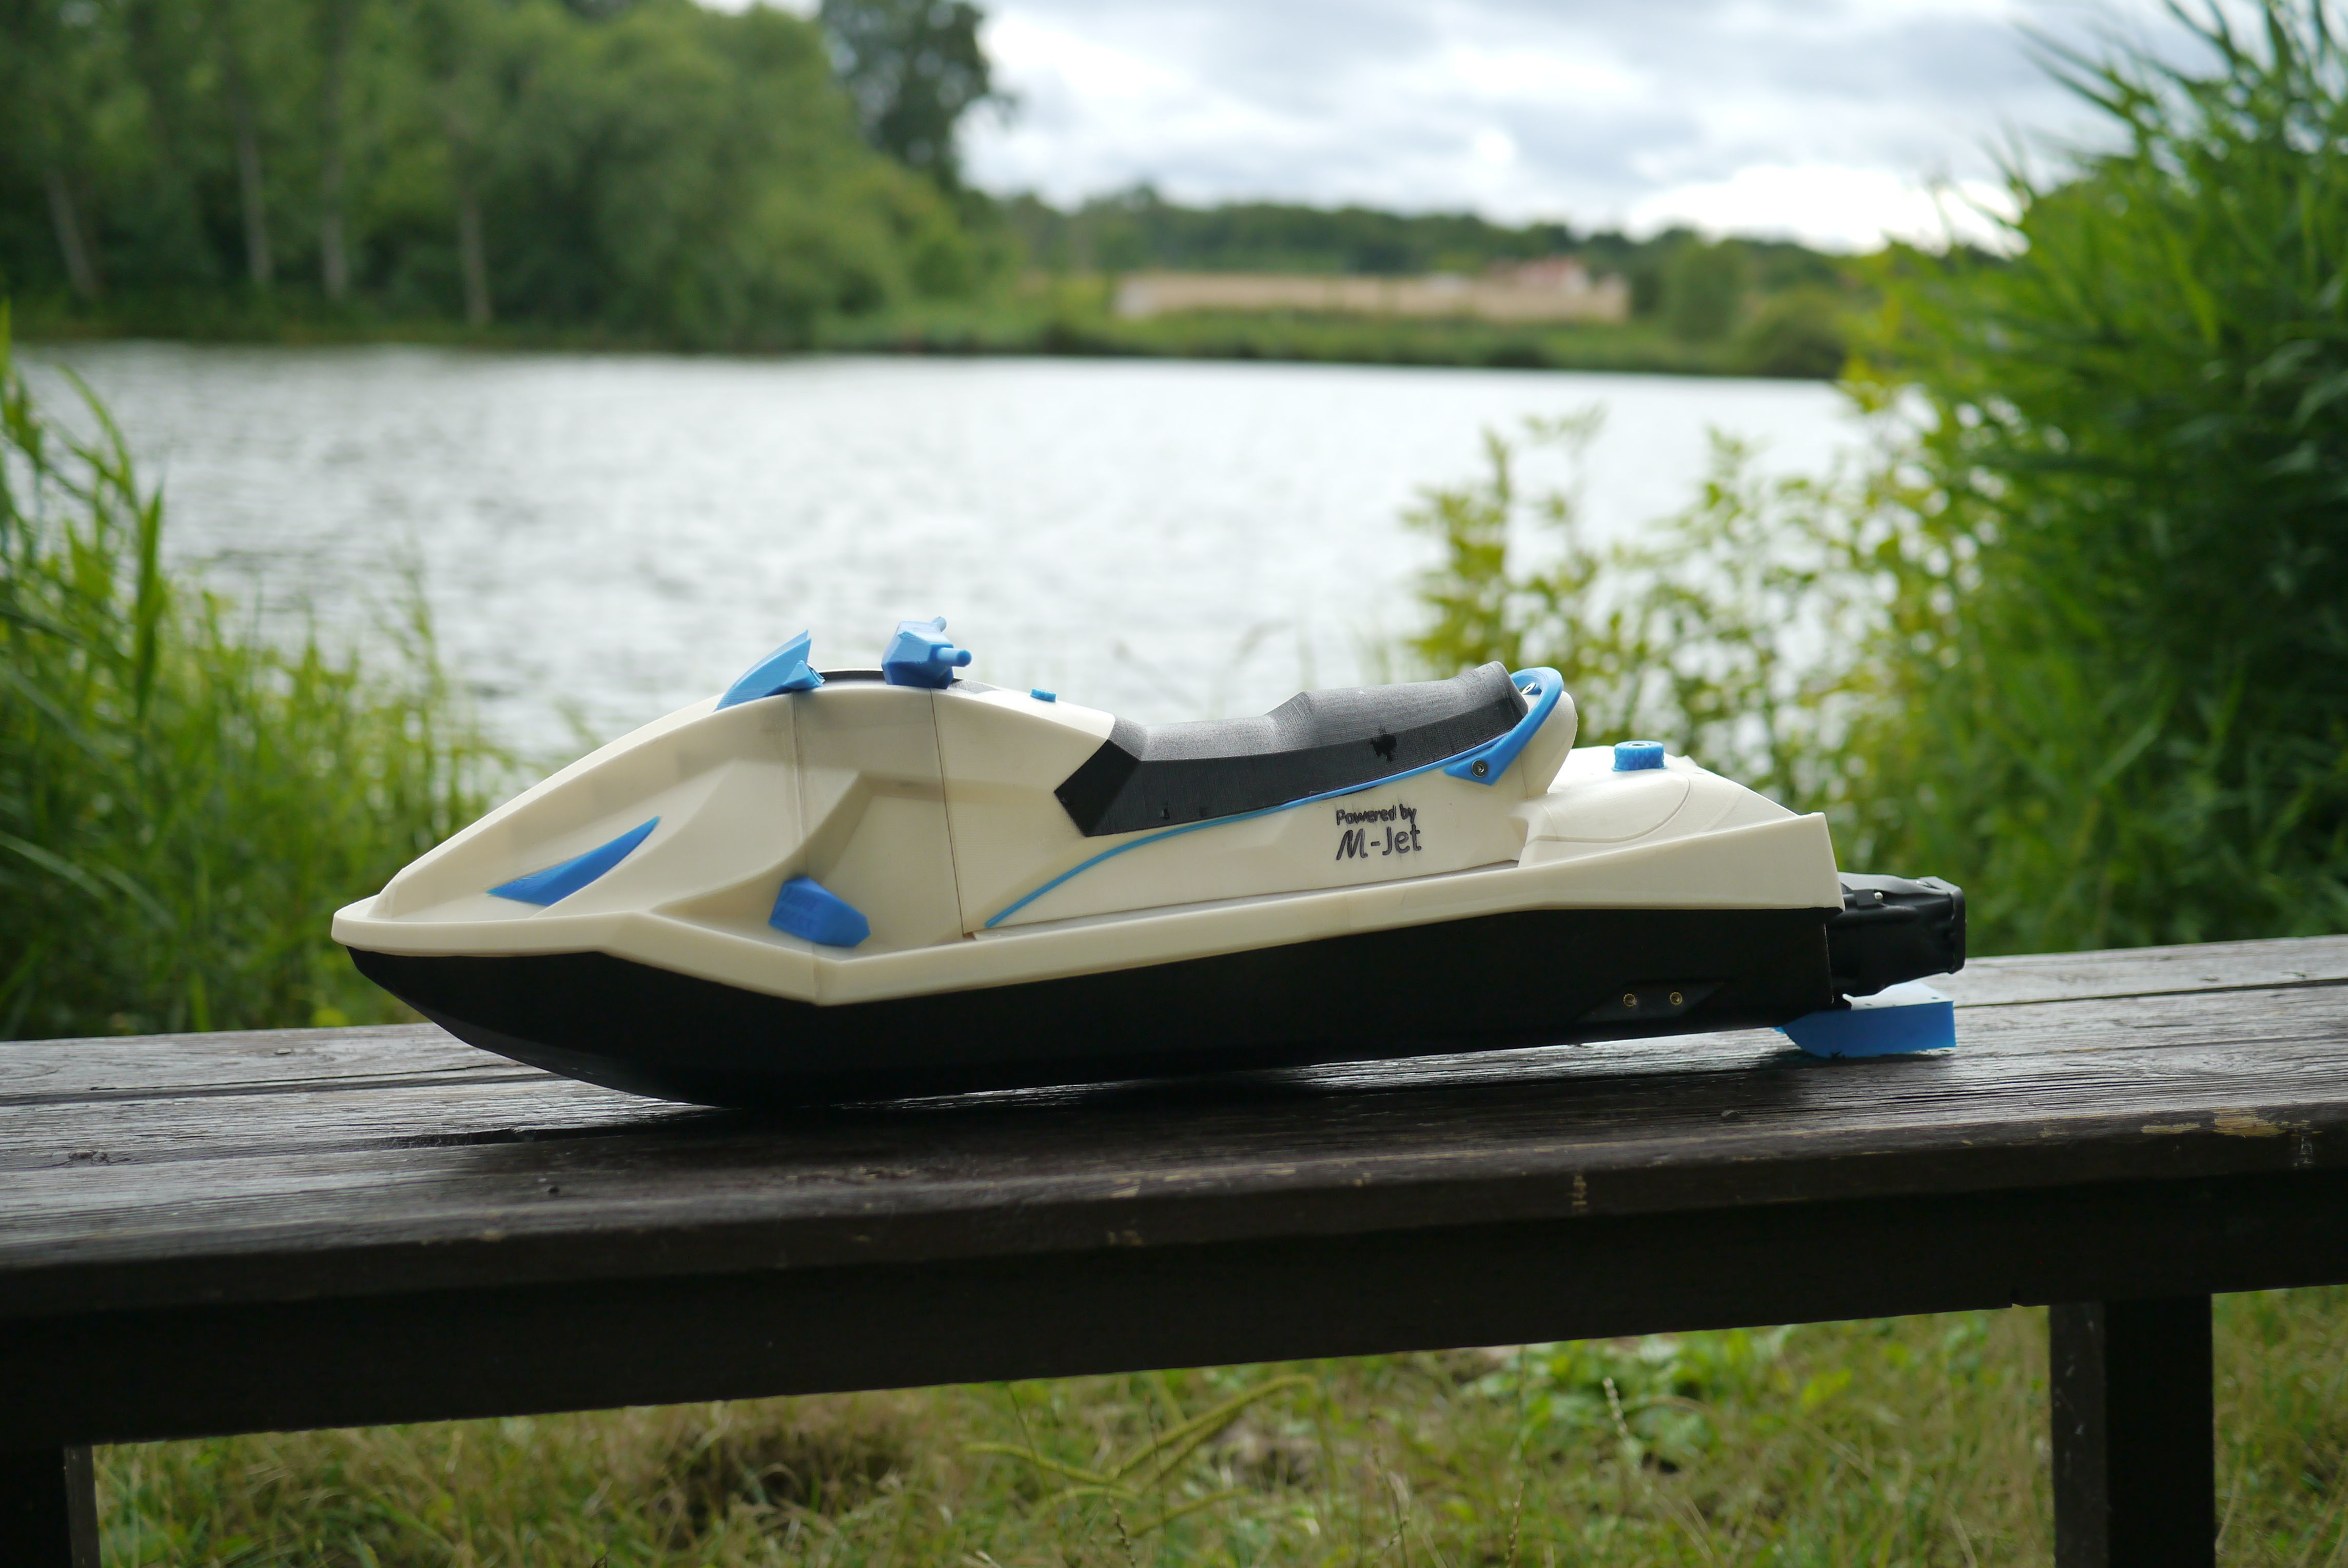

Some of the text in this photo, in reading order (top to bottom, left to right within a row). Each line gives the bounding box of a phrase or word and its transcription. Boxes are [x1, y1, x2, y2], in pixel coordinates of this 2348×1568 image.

[1336, 803, 1417, 826] Powered by
[1336, 824, 1422, 860] M-Jet
